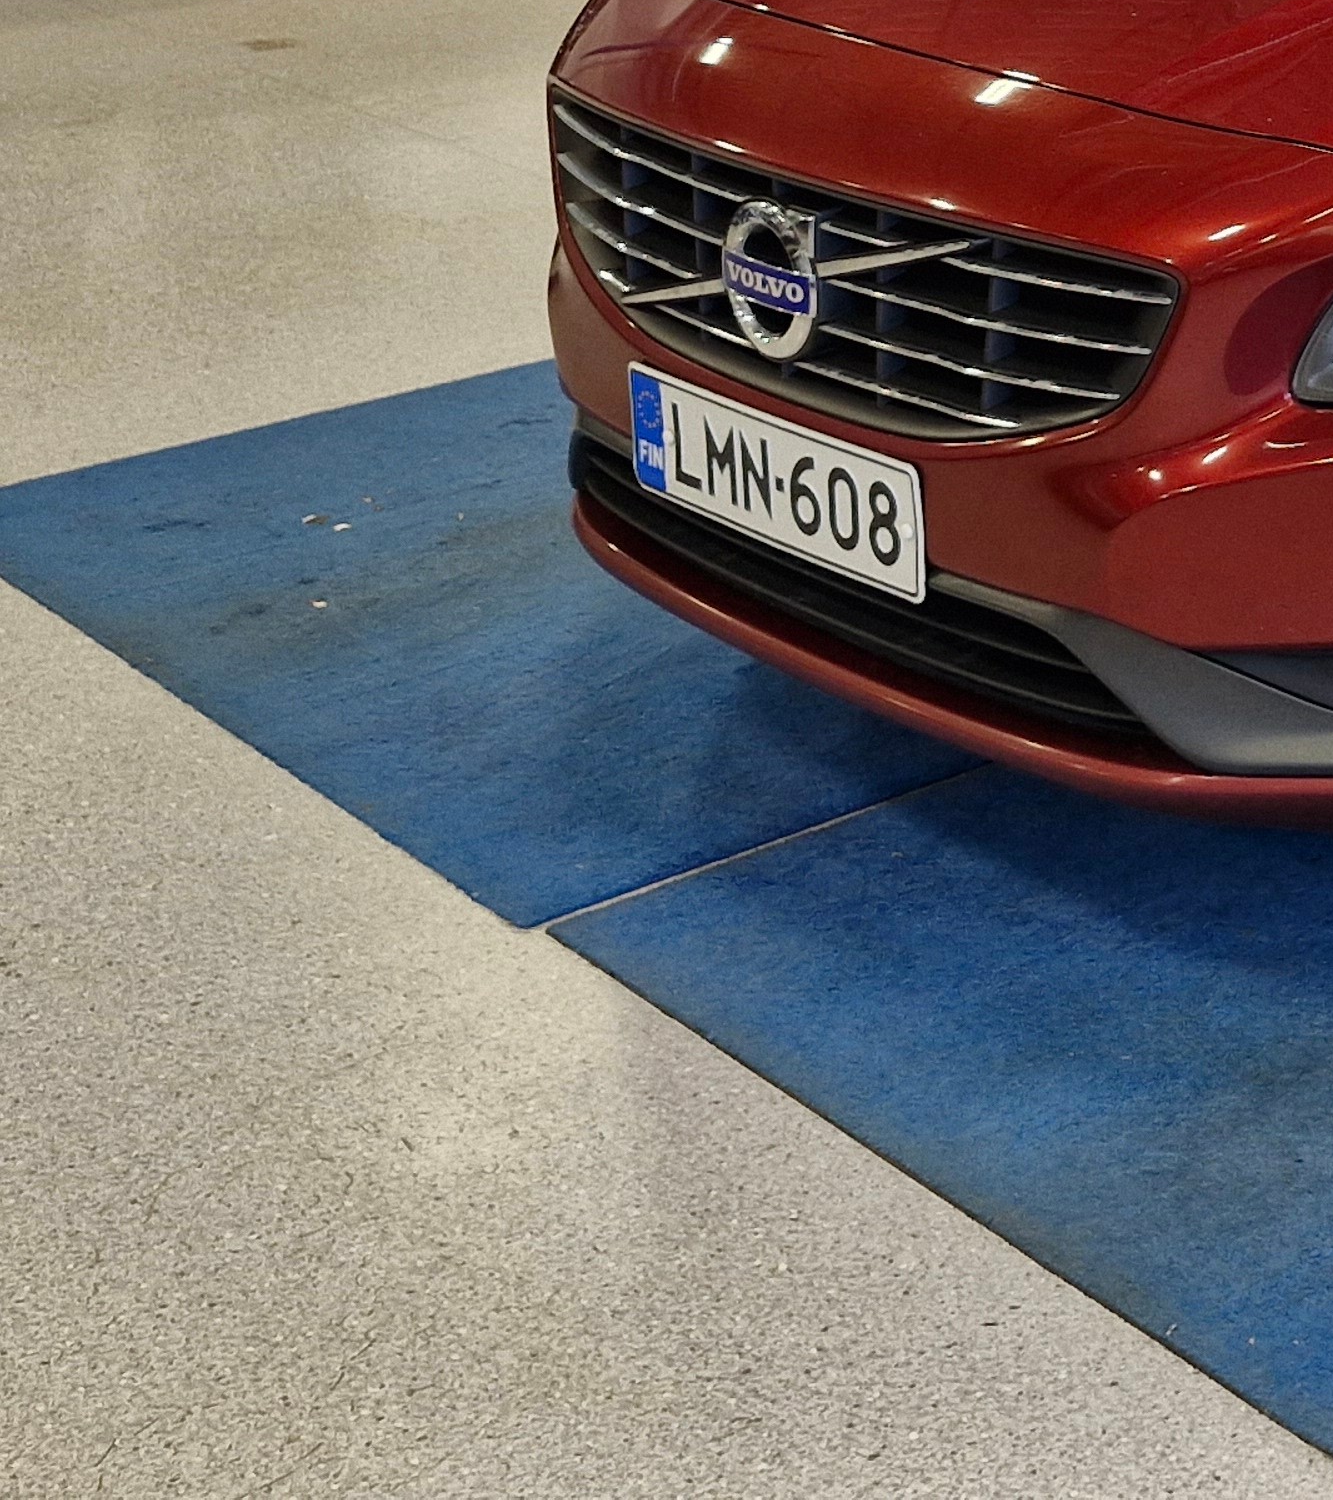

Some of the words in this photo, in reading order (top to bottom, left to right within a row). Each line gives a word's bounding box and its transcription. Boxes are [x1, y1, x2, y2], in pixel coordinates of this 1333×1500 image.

[726, 260, 805, 304] VOLVO
[639, 441, 664, 471] FIN
[671, 401, 901, 567] LMN-608
